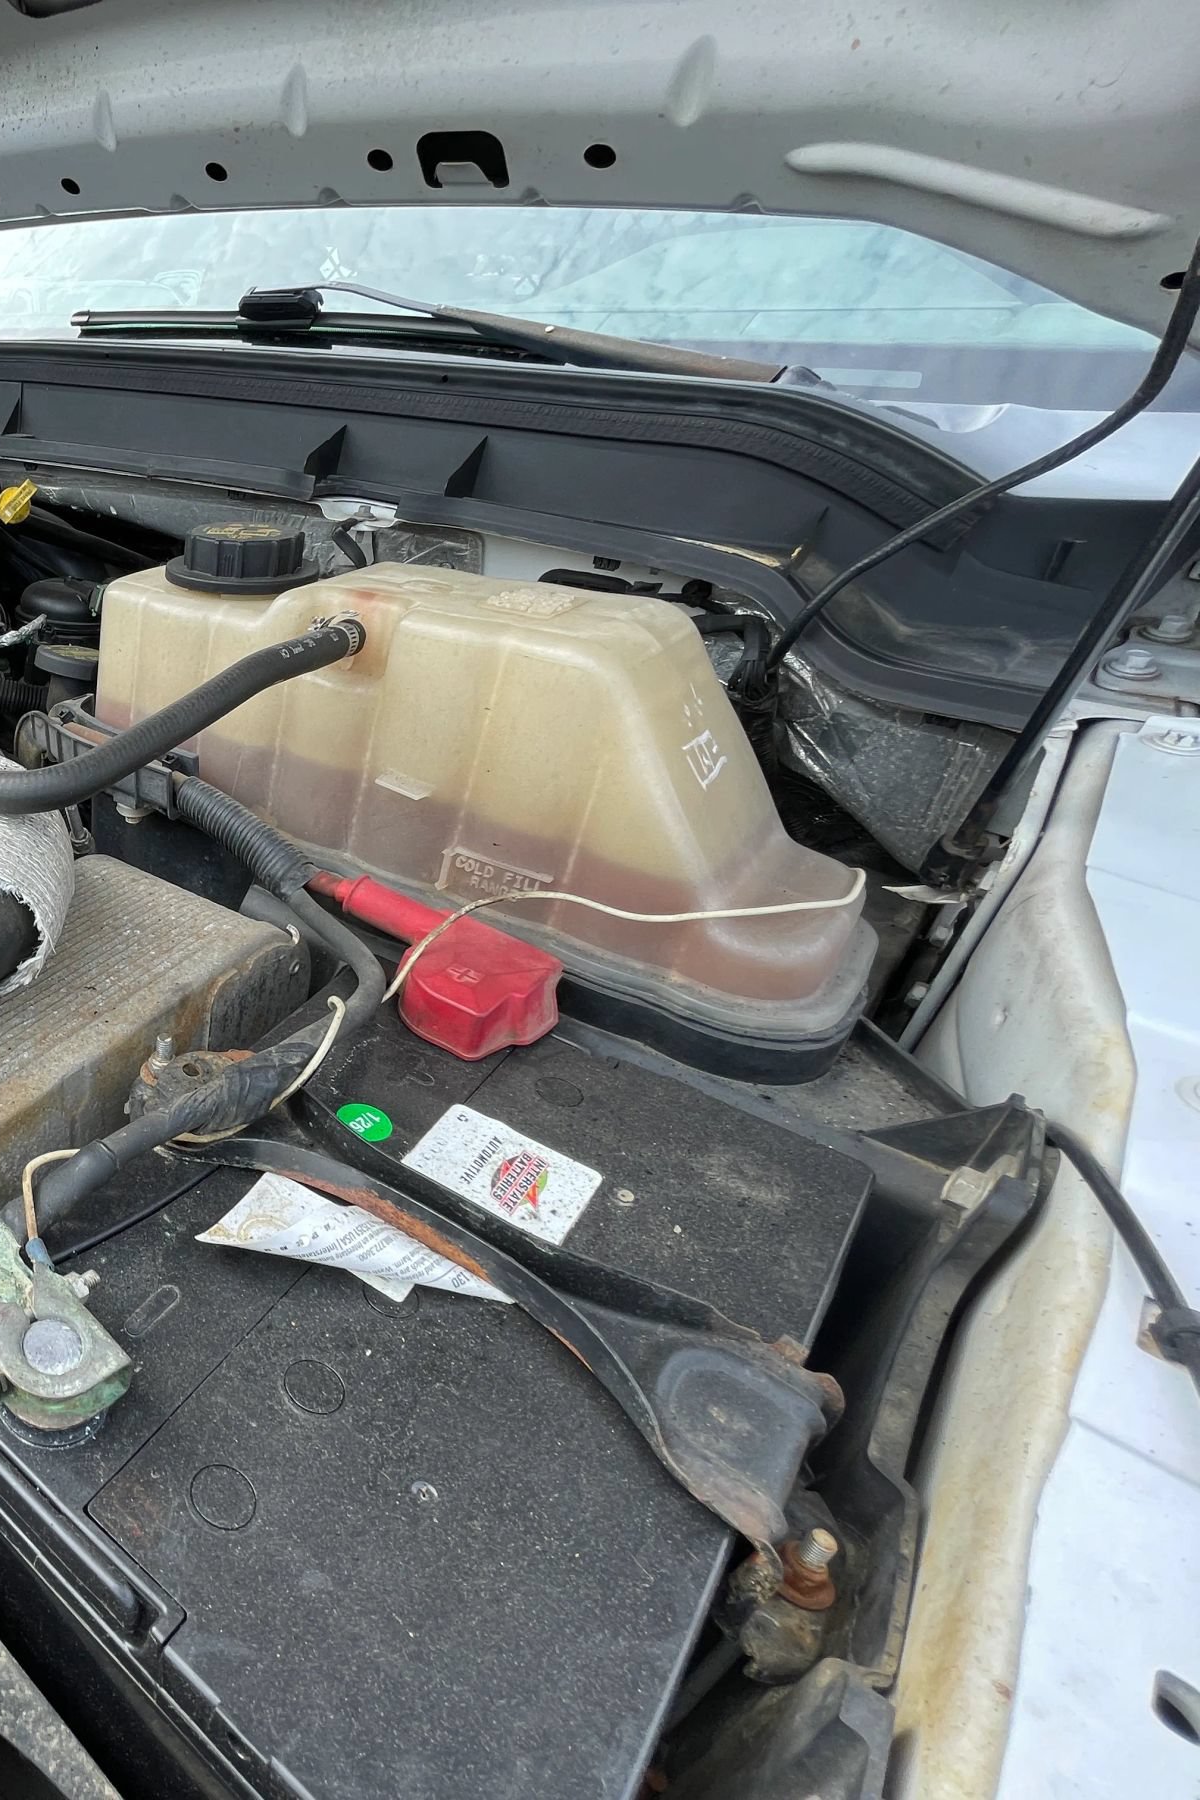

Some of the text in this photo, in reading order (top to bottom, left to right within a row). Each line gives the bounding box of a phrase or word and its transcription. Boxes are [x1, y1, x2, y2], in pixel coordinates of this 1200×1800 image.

[455, 856, 540, 891] COLD FILL
[349, 1112, 380, 1133] 1/26
[460, 1136, 502, 1184] AUTOMOTIVE
[492, 1153, 532, 1200] BATTERIES
[502, 1158, 547, 1212] INTERSTATE
[339, 1230, 357, 1249] USA
[451, 1271, 470, 1289] 130
